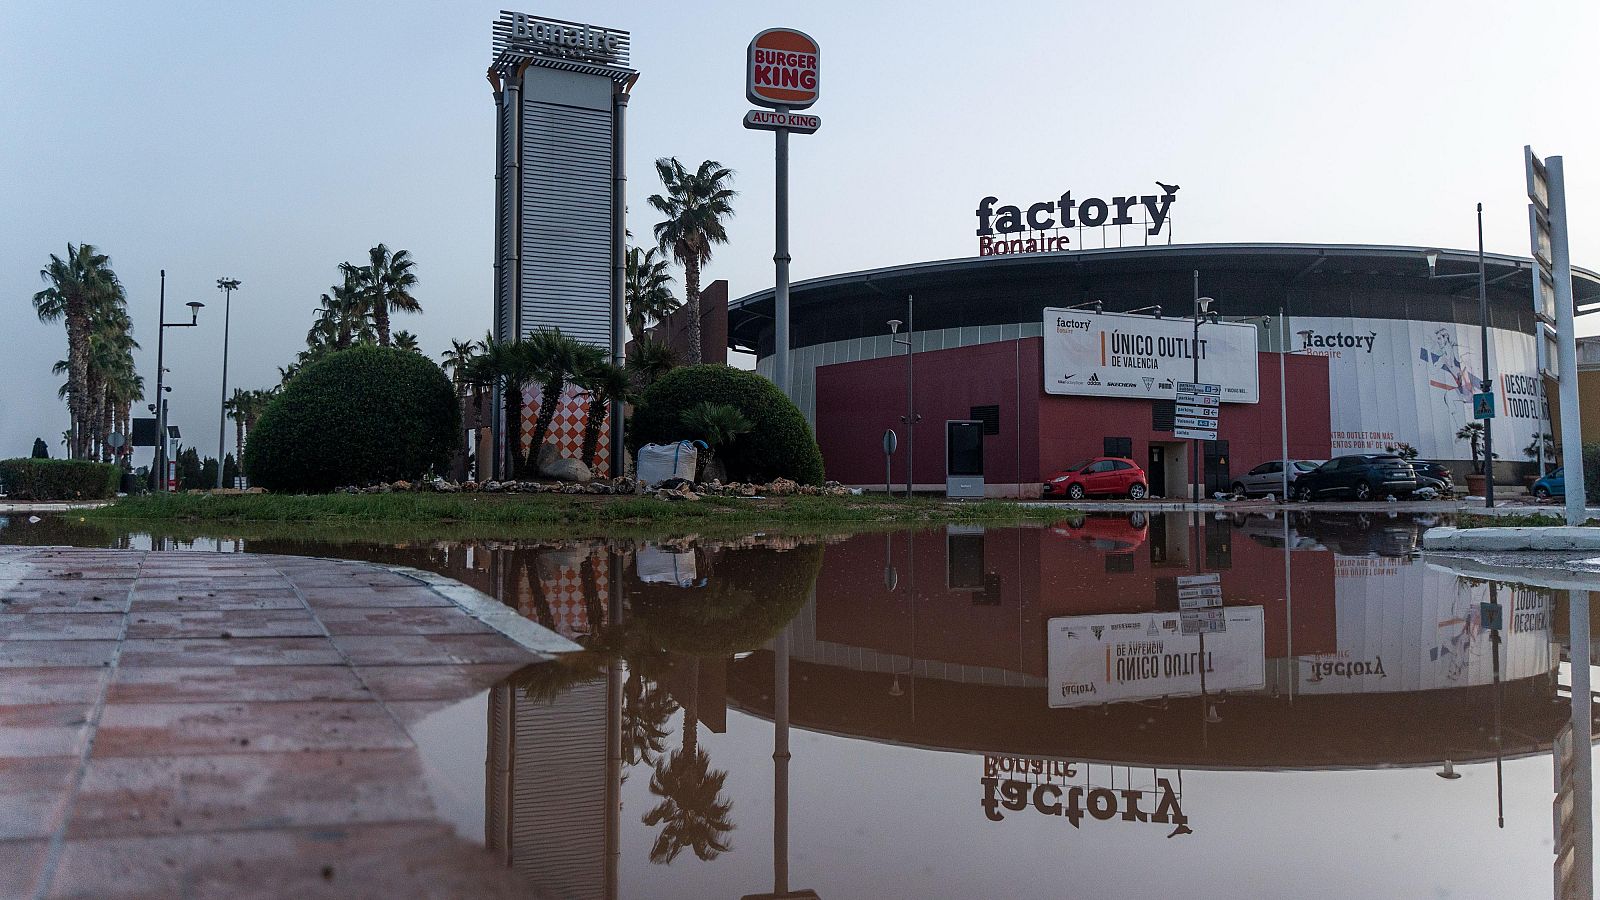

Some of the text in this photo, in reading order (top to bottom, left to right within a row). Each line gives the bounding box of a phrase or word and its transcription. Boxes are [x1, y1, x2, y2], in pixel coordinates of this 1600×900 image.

[512, 12, 619, 52] Bonaire
[755, 50, 816, 69] BURGER
[754, 64, 816, 89] KING
[753, 112, 817, 127] AUTO KING
[976, 189, 1176, 236] factory
[979, 232, 1070, 257] Bonaire
[1056, 317, 1091, 331] factory
[1111, 329, 1153, 357] ÚNICO
[1306, 330, 1375, 353] factory
[1111, 355, 1159, 369] DE VALENCIA
[1507, 398, 1530, 418] TODO
[1530, 399, 1539, 420] EL
[1346, 431, 1368, 439] OUTLET
[1369, 431, 1381, 440] CON
[1353, 440, 1366, 449] POR
